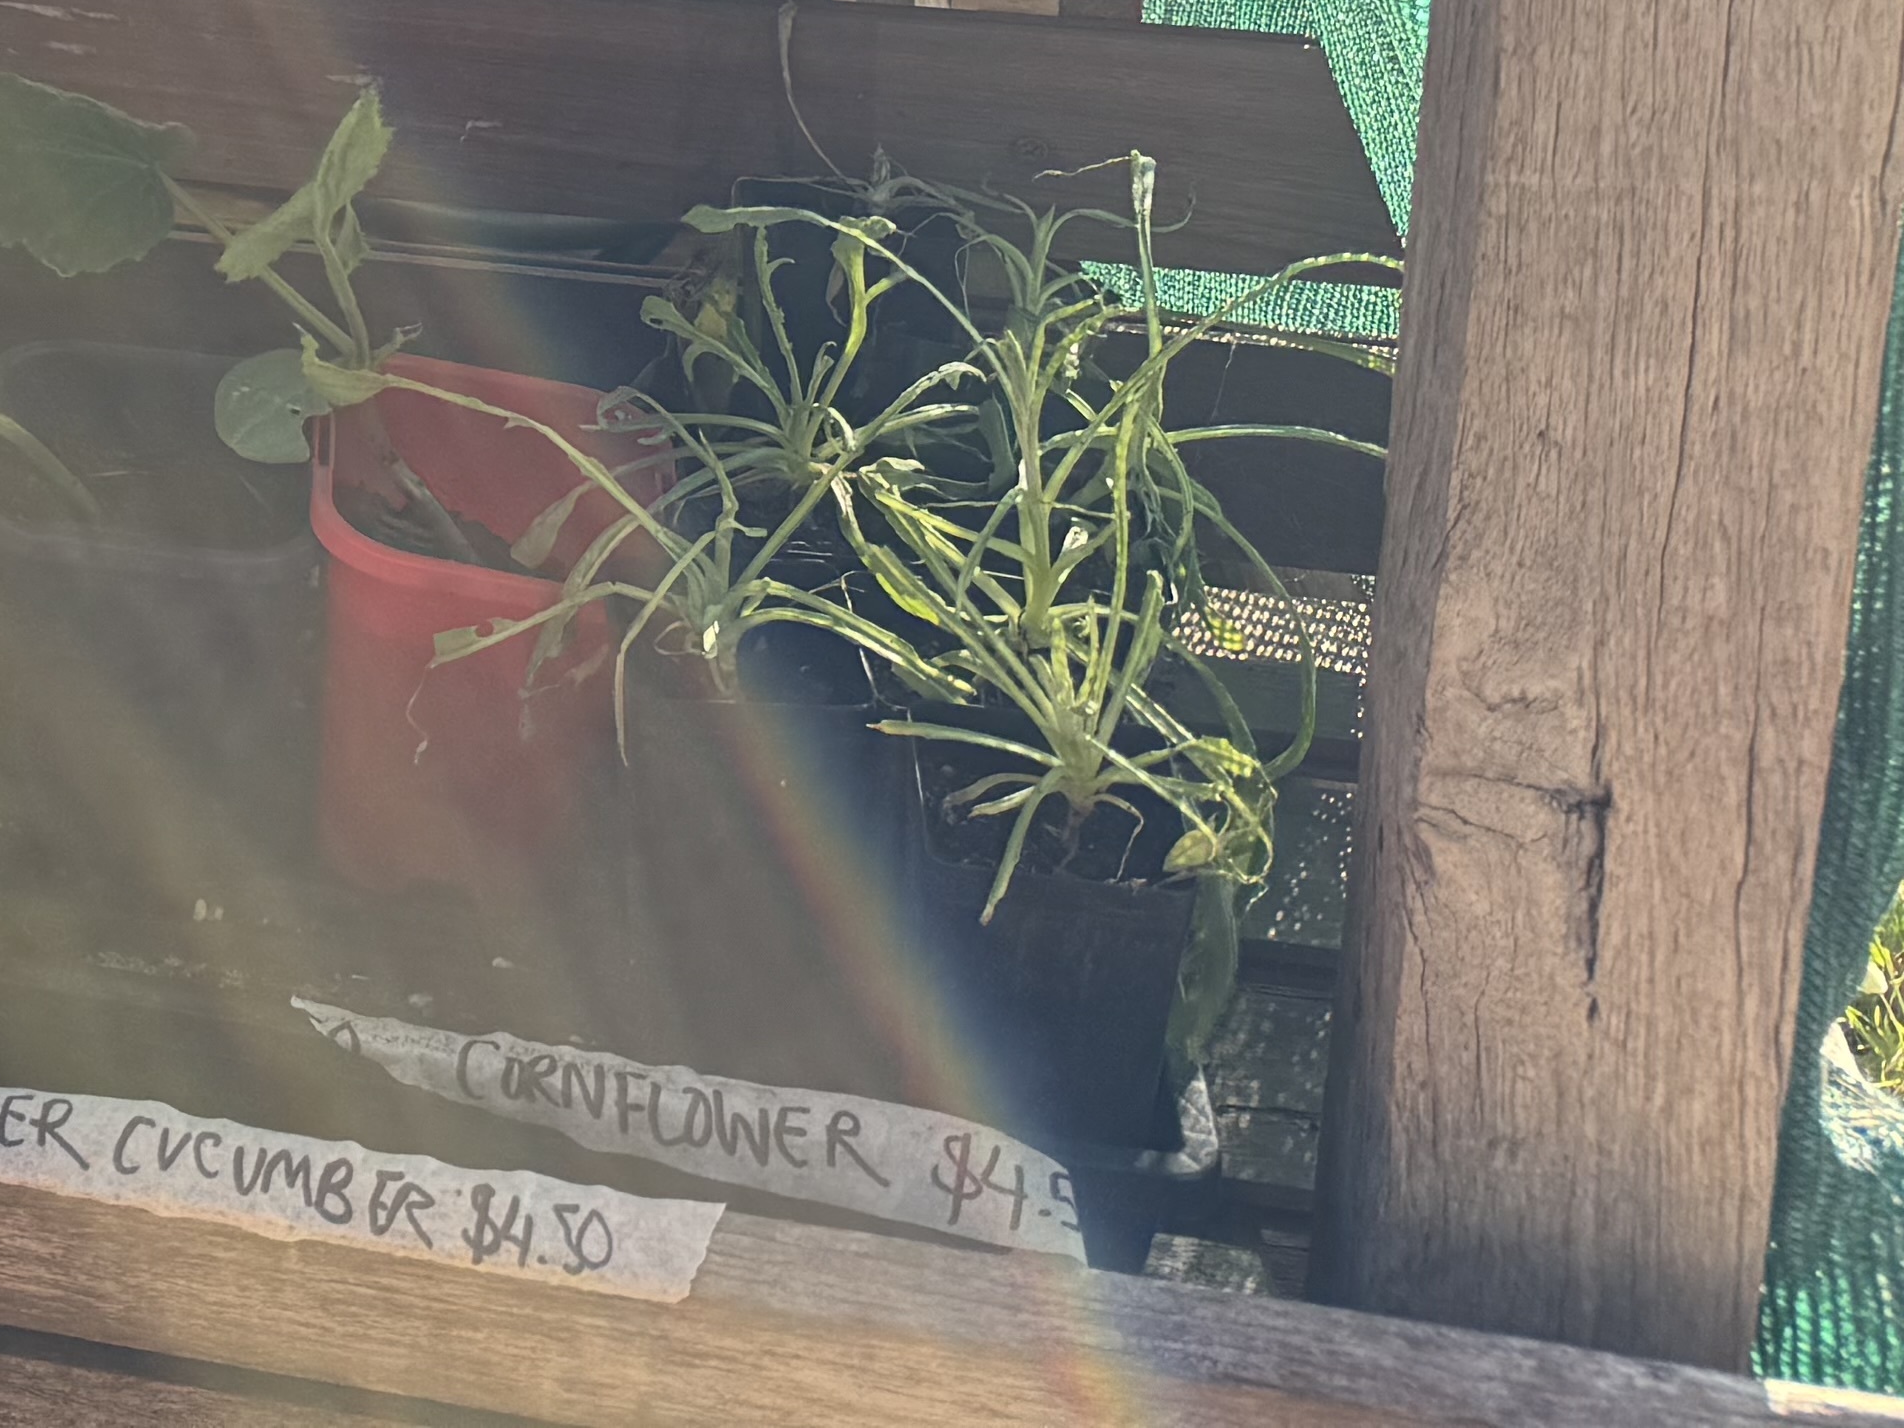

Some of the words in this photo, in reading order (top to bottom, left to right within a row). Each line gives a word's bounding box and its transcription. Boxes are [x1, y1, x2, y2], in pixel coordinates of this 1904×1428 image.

[456, 1039, 890, 1189] CORNFLOWER
[111, 1114, 435, 1251] CUCUMBER
[462, 1182, 614, 1276] $4.50
